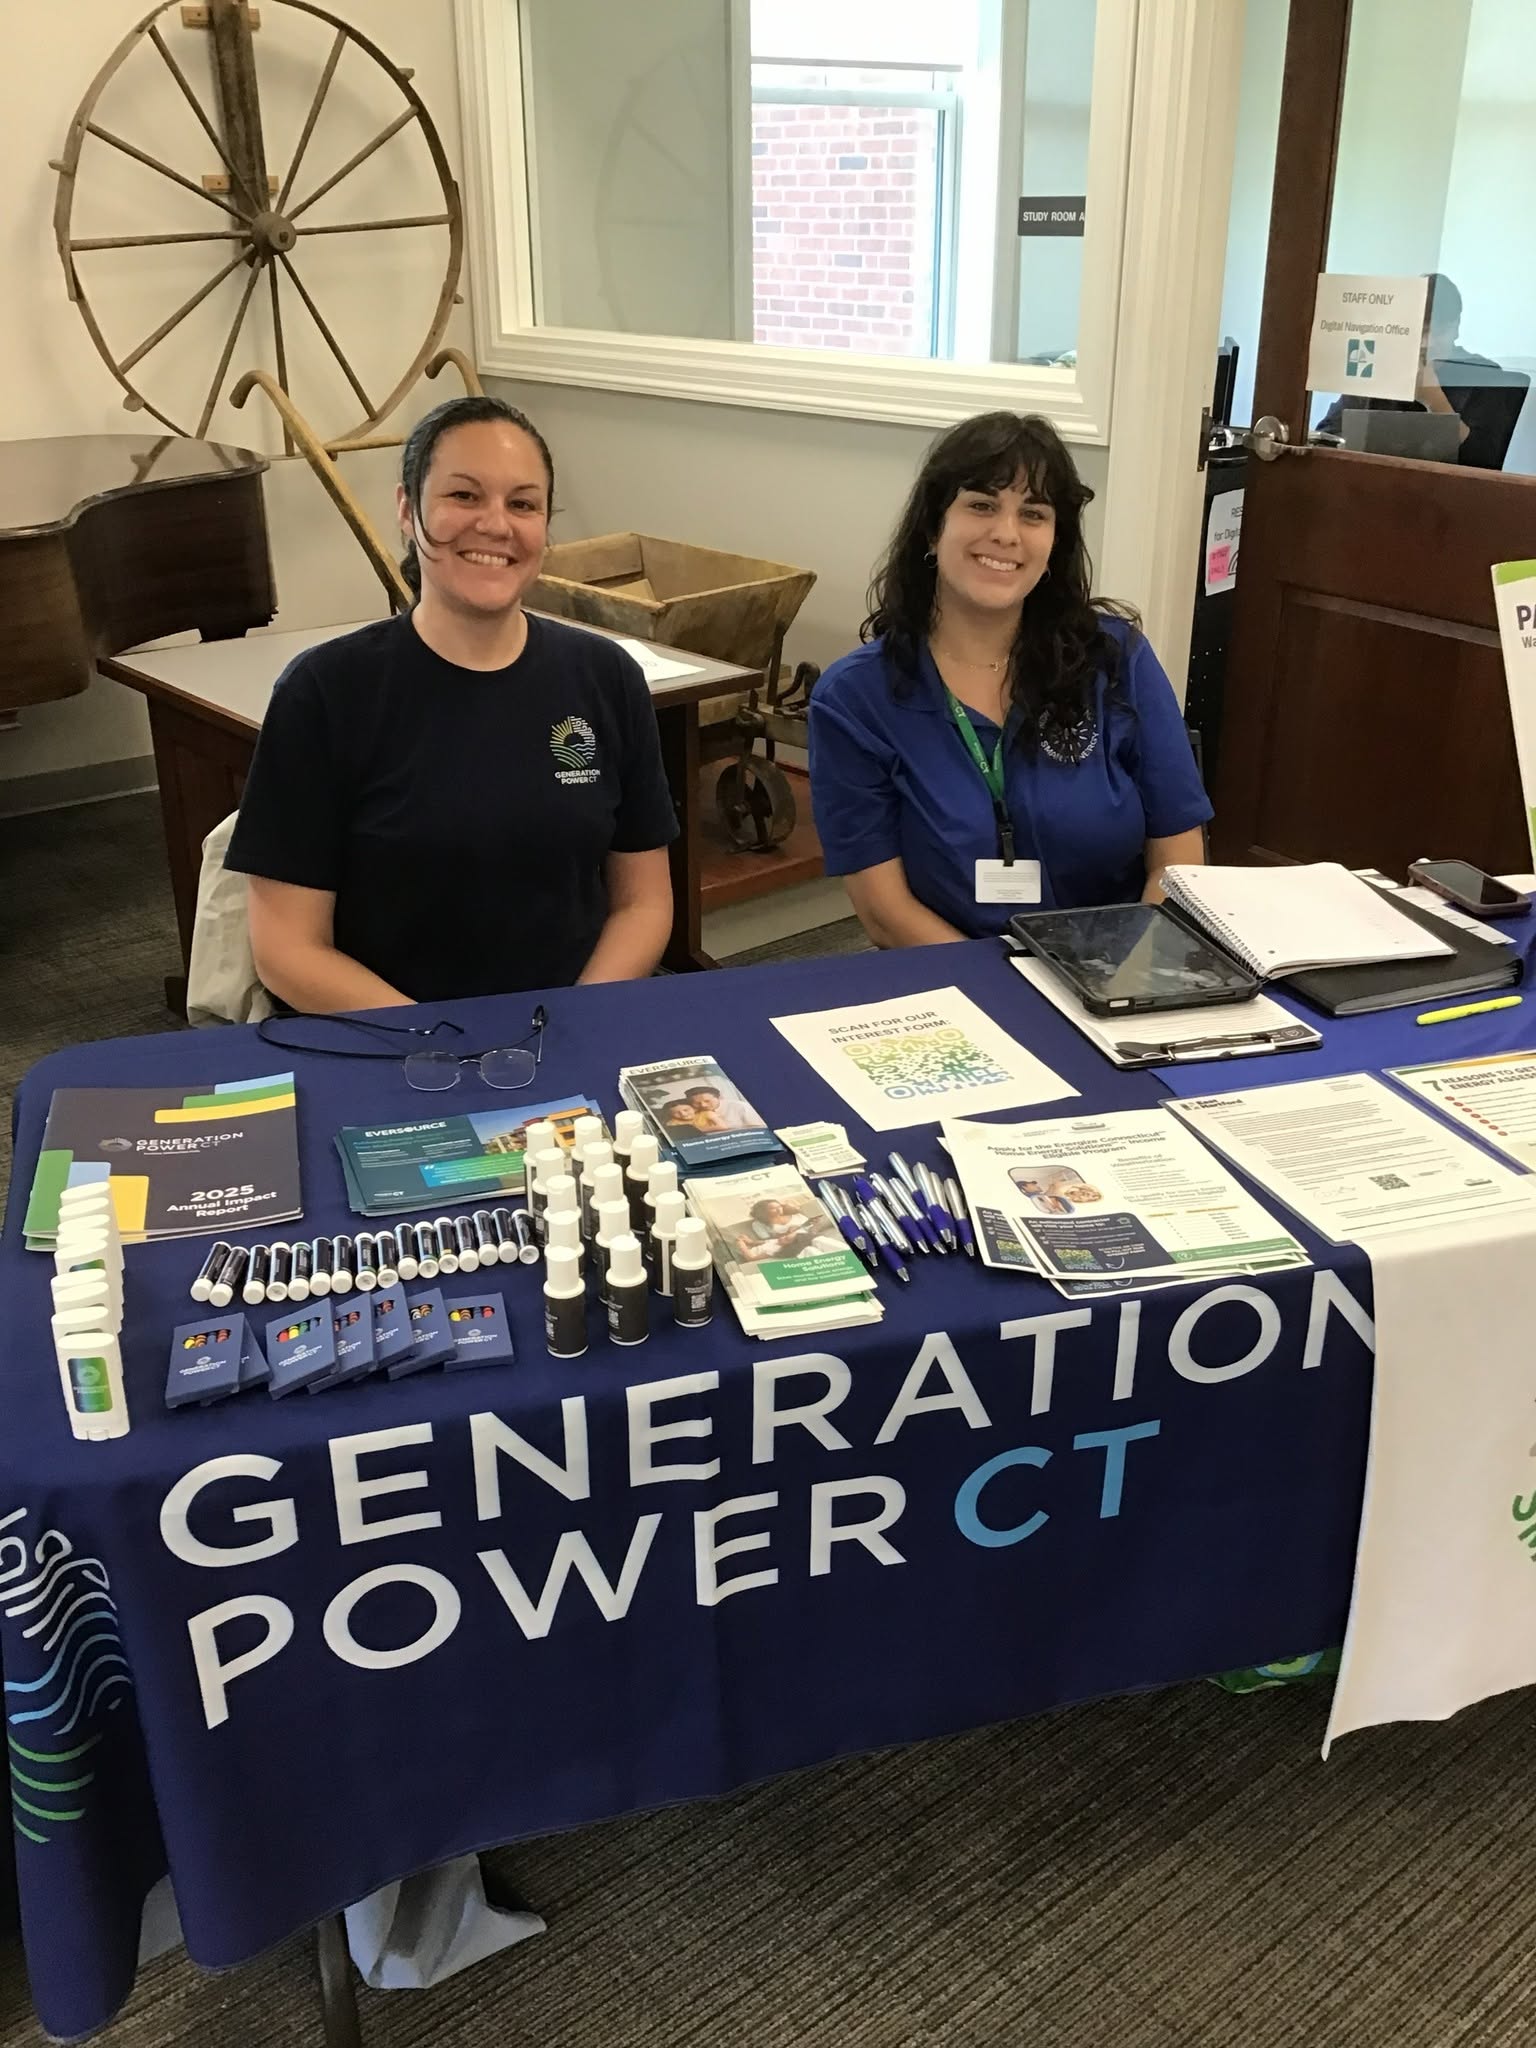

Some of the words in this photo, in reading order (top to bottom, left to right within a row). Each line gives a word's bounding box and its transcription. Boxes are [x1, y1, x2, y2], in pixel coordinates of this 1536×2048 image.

[1023, 211, 1048, 222] STUDY
[1051, 211, 1076, 222] ROOM
[1342, 292, 1367, 304] STAFF
[1368, 293, 1394, 305] ONLY
[1321, 320, 1343, 333] Digital
[1345, 322, 1383, 335] Navigation
[1385, 324, 1410, 336] Office
[554, 769, 600, 779] GENERATION
[561, 777, 588, 785] POWER
[828, 1023, 870, 1035] SCAN
[872, 1017, 904, 1030] FOR
[904, 1010, 938, 1023] OUR
[831, 1027, 901, 1044] INTEREST
[903, 1018, 952, 1032] FORM:
[629, 1058, 708, 1075] EVERSOURCE
[1440, 1072, 1496, 1084] REASONS
[1496, 1069, 1514, 1077] TO
[1421, 1080, 1443, 1091] 7
[1449, 1078, 1496, 1090] ENERGY
[364, 1121, 448, 1138] EVERSOURCE
[136, 1132, 244, 1146] GENERATION
[136, 1142, 200, 1152] POWER
[200, 1140, 220, 1148] CT
[1053, 1138, 1098, 1148] Energize
[1042, 1151, 1081, 1159] Eligible
[1082, 1145, 1127, 1156] Program
[191, 1184, 255, 1202] 2025
[167, 1200, 221, 1212] Annual
[224, 1191, 277, 1209] Impact
[195, 1204, 249, 1218] Report
[783, 1261, 812, 1269] Home
[813, 1255, 846, 1265] Energy
[802, 1261, 846, 1272] Solutions
[159, 1284, 1375, 1568] GENERATION
[188, 1475, 907, 1730] POWER
[954, 1418, 1162, 1549] CT
